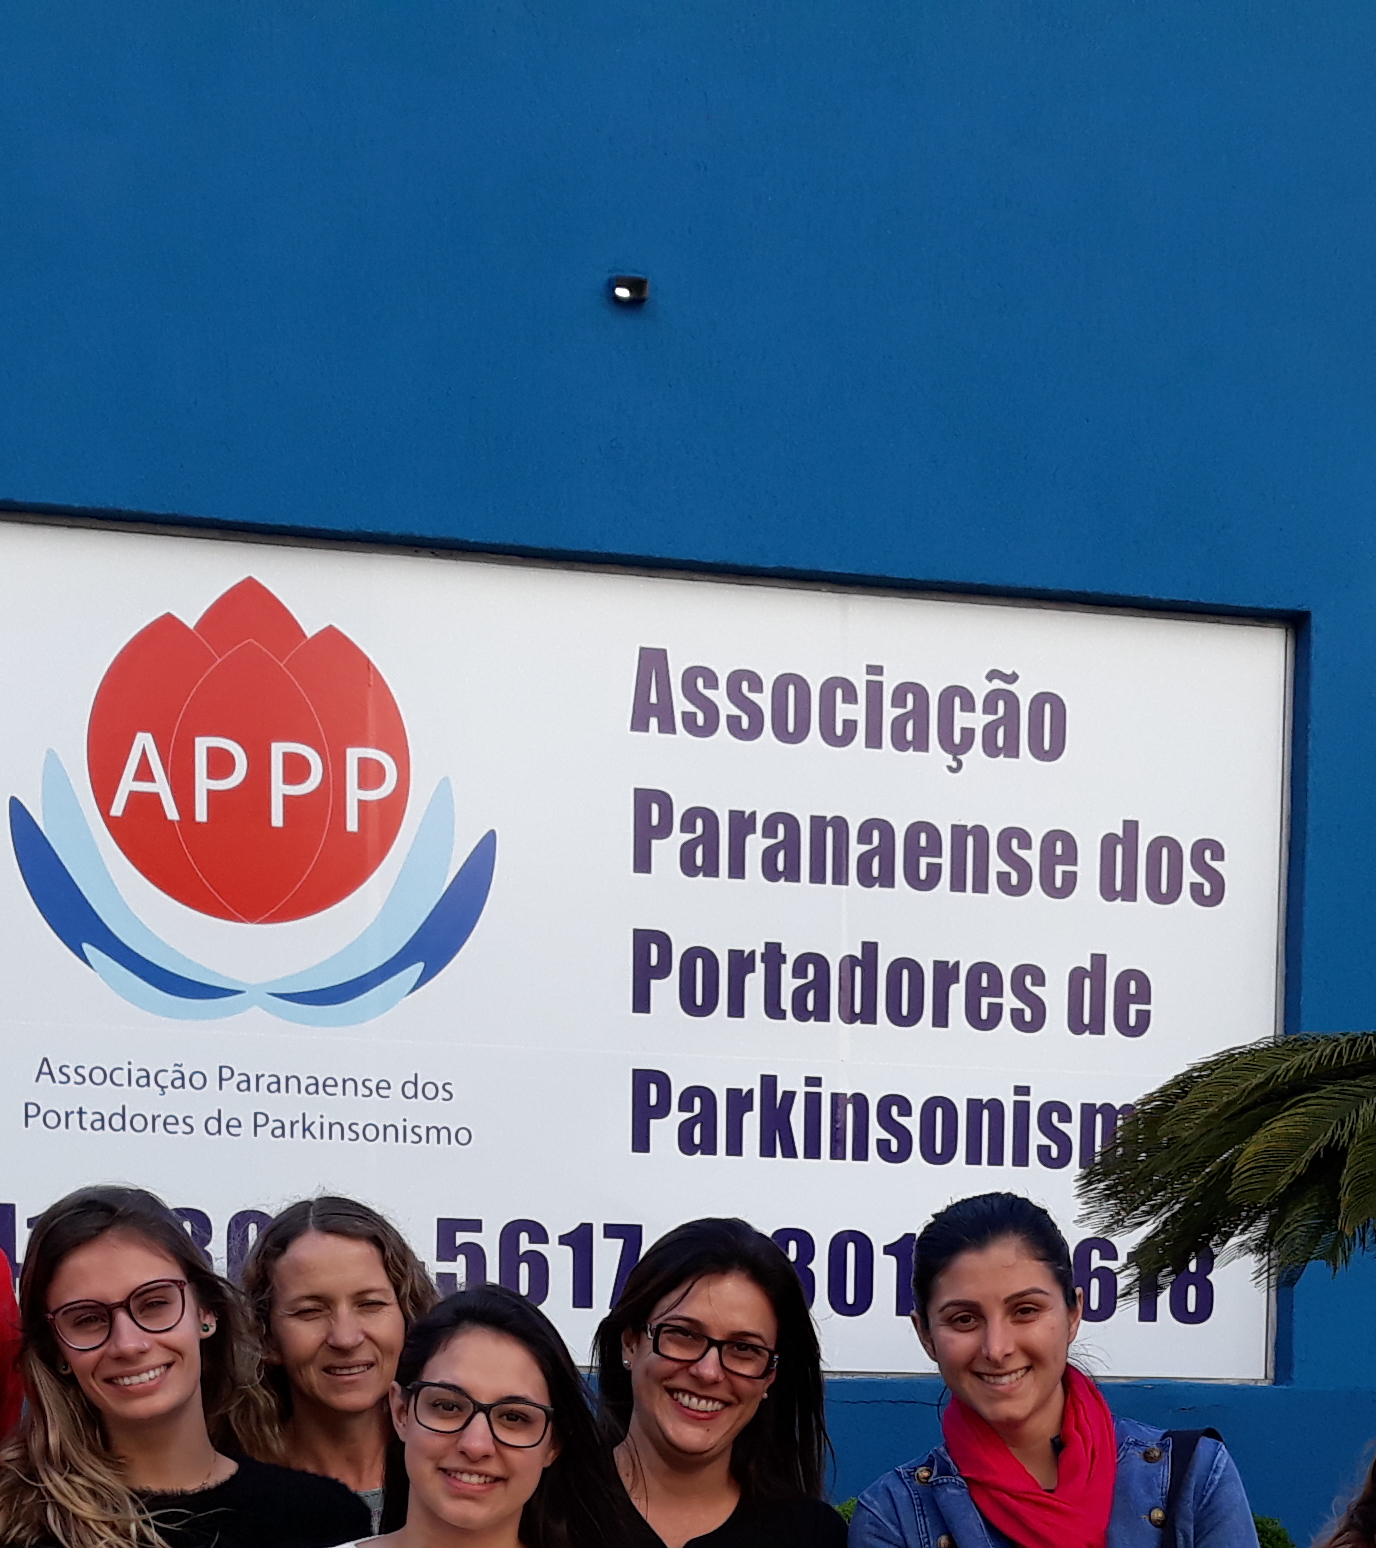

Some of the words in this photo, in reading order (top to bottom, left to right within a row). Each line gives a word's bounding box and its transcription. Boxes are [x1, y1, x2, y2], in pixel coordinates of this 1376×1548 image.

[630, 646, 1067, 773] Associação
[110, 731, 398, 832] APPP
[633, 788, 1077, 900] Paranaense
[1100, 820, 1226, 907] dos
[632, 928, 1046, 1034] Portadores
[1068, 953, 1152, 1038] de
[24, 1102, 195, 1136] Portadores
[204, 1108, 242, 1137] de
[253, 1111, 473, 1147] Parkinsonismo
[35, 1057, 207, 1096] Associação
[218, 1065, 392, 1099] Paranaense
[401, 1073, 454, 1102] dos
[632, 1069, 1136, 1170] Parkinsonism
